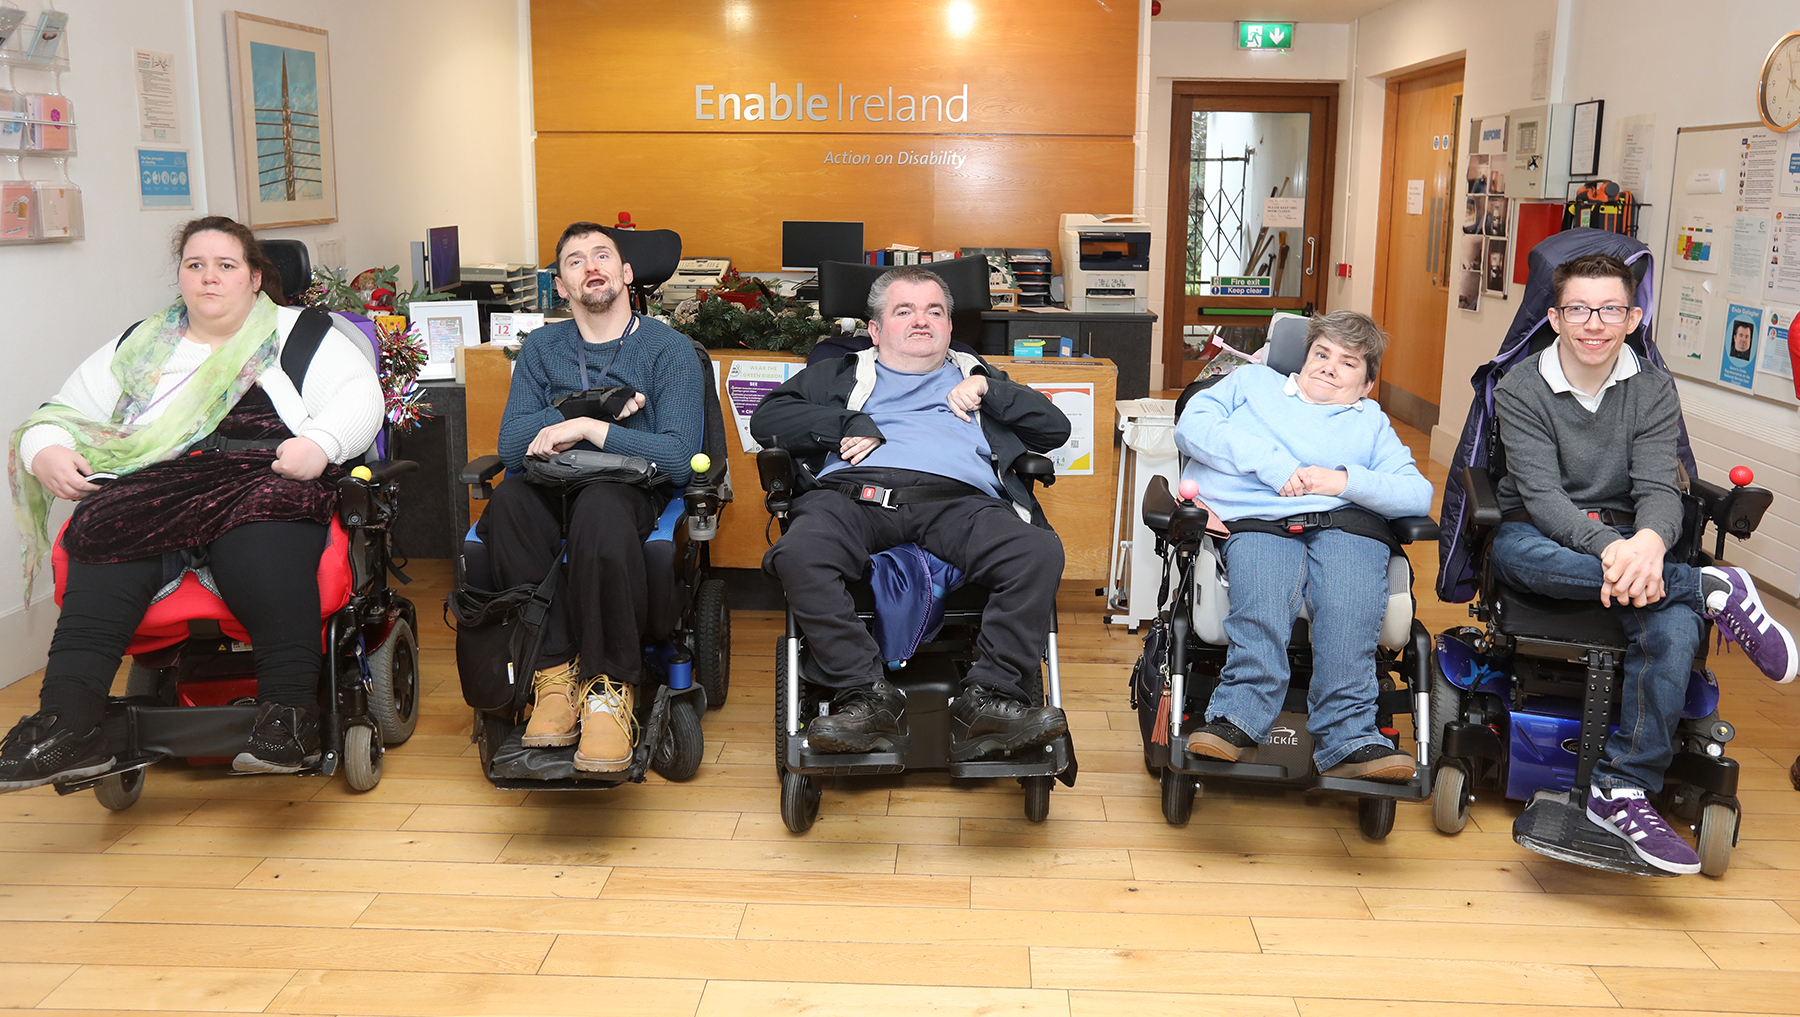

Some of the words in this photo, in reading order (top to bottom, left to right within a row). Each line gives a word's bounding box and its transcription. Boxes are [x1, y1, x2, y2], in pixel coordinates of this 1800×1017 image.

[1771, 80, 1776, 88] 9
[695, 82, 828, 121] Enable
[838, 83, 968, 122] Ireland
[1771, 95, 1776, 104] 8
[1786, 110, 1791, 119] 6
[823, 151, 871, 165] Action
[874, 154, 893, 165] on
[897, 151, 966, 169] Disability
[498, 325, 509, 335] 12
[1270, 735, 1299, 746] ICKIE
